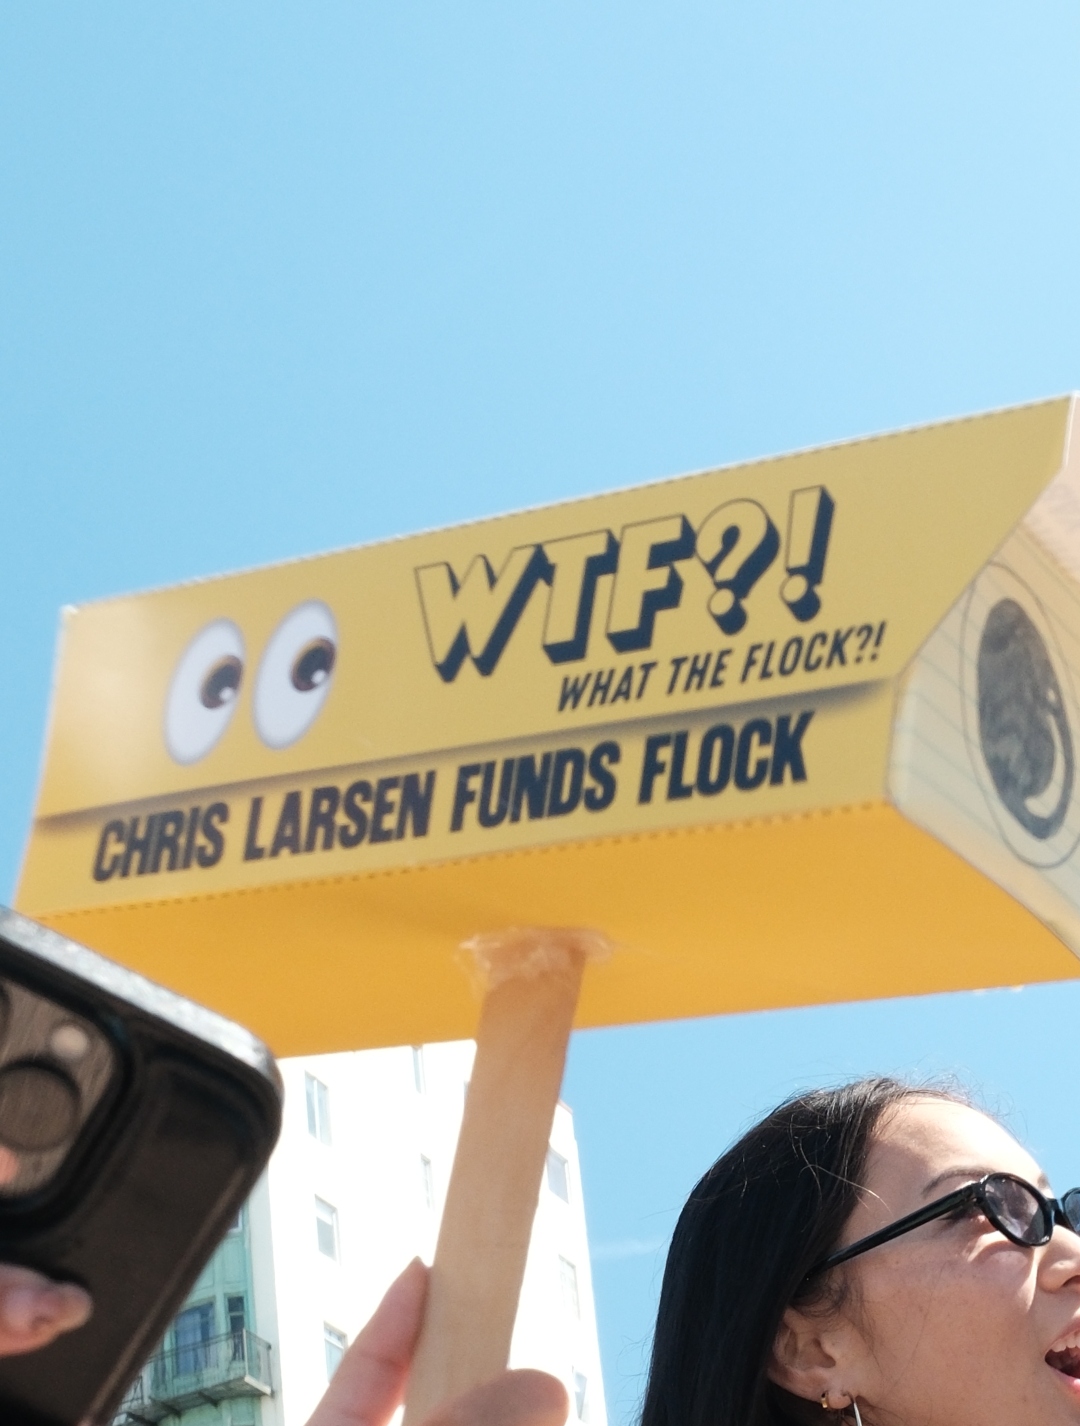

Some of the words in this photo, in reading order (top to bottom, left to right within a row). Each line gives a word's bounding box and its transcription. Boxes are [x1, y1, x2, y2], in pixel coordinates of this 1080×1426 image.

[414, 484, 836, 683] WTF?!
[557, 661, 659, 713] WHAT
[666, 647, 733, 696] THE
[740, 620, 887, 684] FLOCK?!
[93, 801, 231, 882] CHRIS
[243, 769, 436, 862] LARSEN
[449, 739, 621, 834] FUNDS
[637, 711, 816, 805] FLOCK
